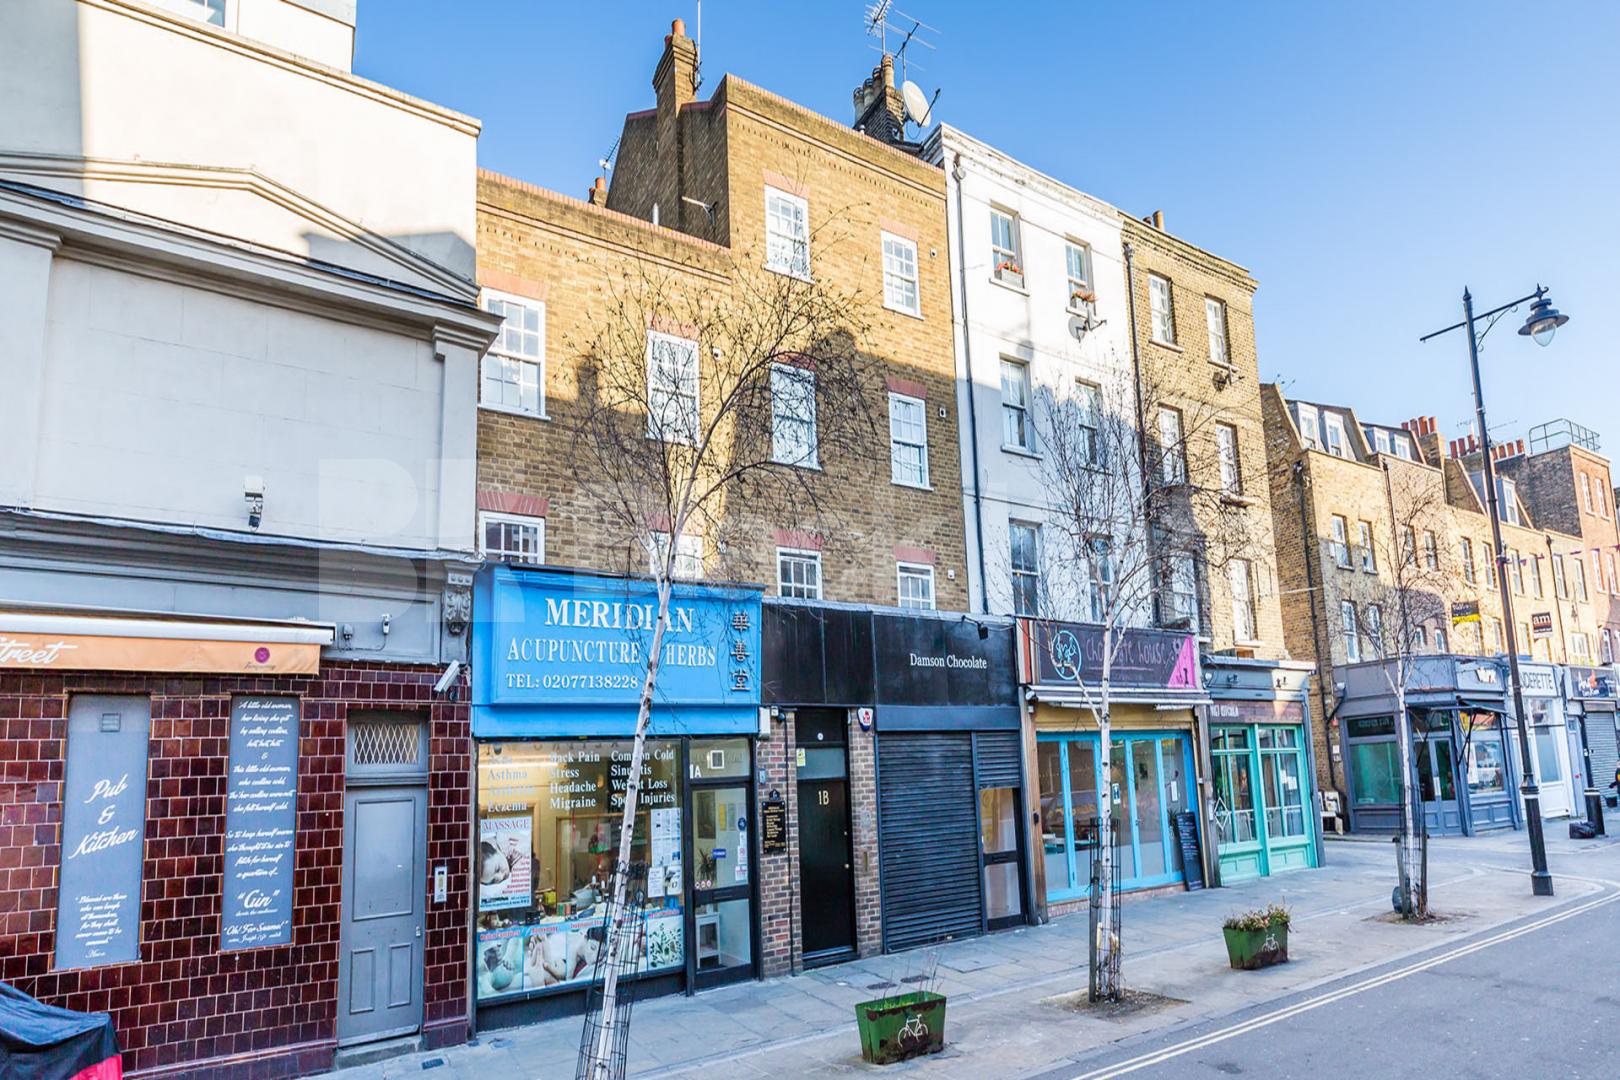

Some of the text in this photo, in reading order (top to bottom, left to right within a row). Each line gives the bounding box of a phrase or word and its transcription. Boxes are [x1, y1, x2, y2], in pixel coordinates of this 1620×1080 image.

[545, 598, 694, 633] MERIDIAN
[507, 637, 716, 667] ACUPUNCTURE HERBS
[910, 653, 988, 669] Damson Chocolate
[506, 673, 639, 689] TEL: 02077138228
[578, 751, 600, 763] Pain
[611, 748, 674, 761] Comon Cold
[488, 769, 528, 781] Asthma
[550, 767, 579, 778] Stress
[611, 764, 652, 776] Sinutis
[690, 764, 701, 779] 1A
[83, 773, 128, 804] Pub
[550, 782, 596, 794] Headache
[648, 778, 668, 789] Loss
[550, 797, 597, 810] Migraine
[641, 791, 675, 806] Injuries
[818, 790, 829, 805] 1B
[488, 800, 528, 812] Eczema
[97, 804, 116, 825] &
[483, 820, 529, 832] MASSAGE
[67, 825, 139, 860] Kitchen
